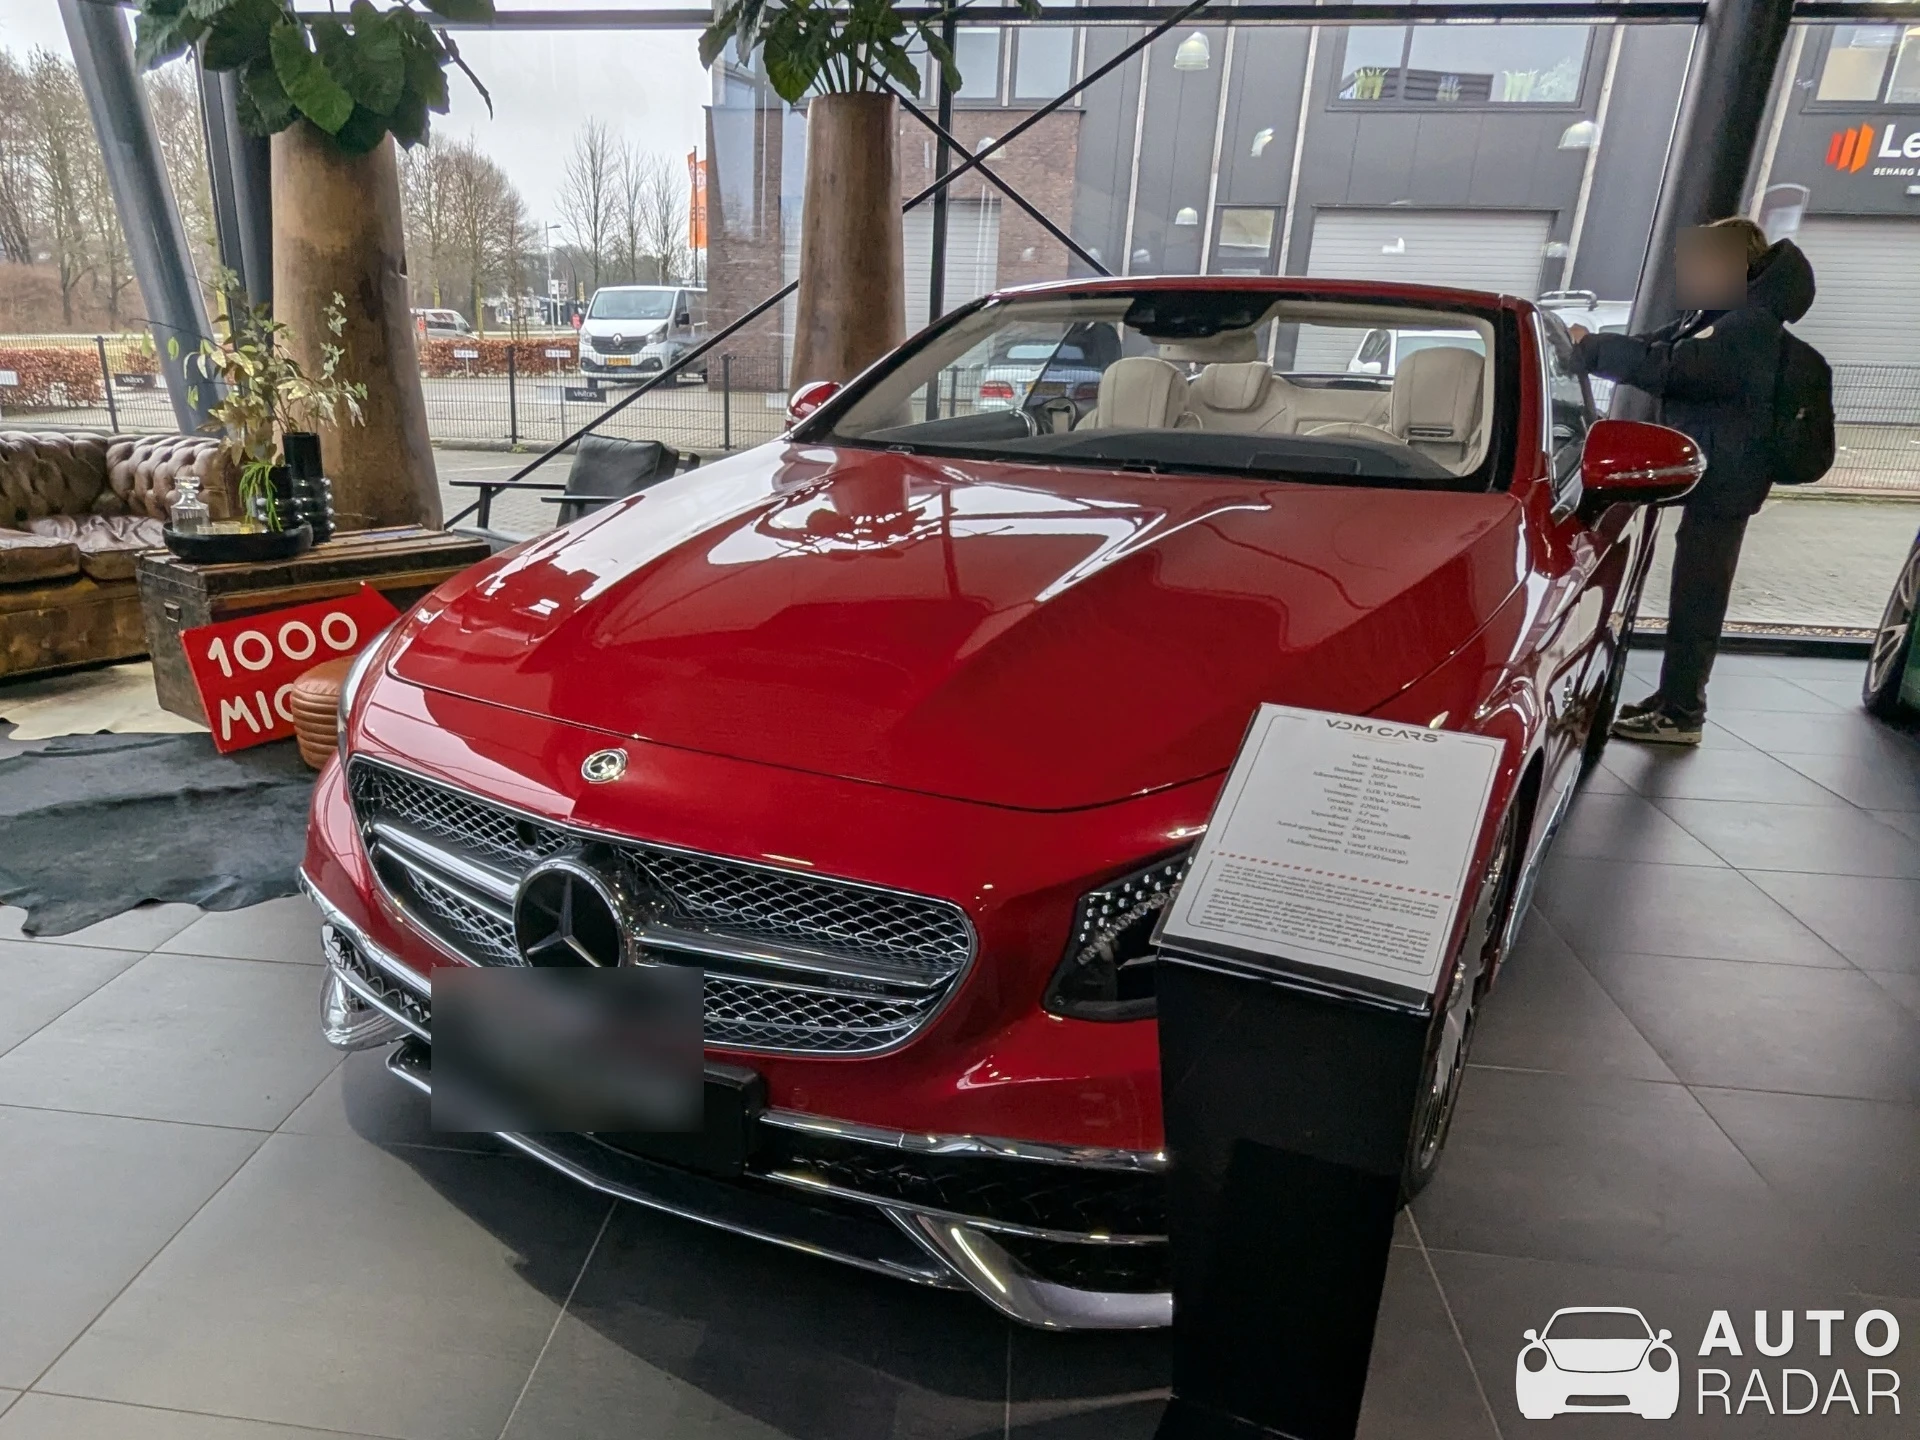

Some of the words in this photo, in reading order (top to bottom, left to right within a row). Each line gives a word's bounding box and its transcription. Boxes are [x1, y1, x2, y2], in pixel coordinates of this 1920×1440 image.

[1873, 167, 1915, 176] BEHANG
[208, 612, 358, 678] 1000
[1377, 727, 1438, 743] CARS
